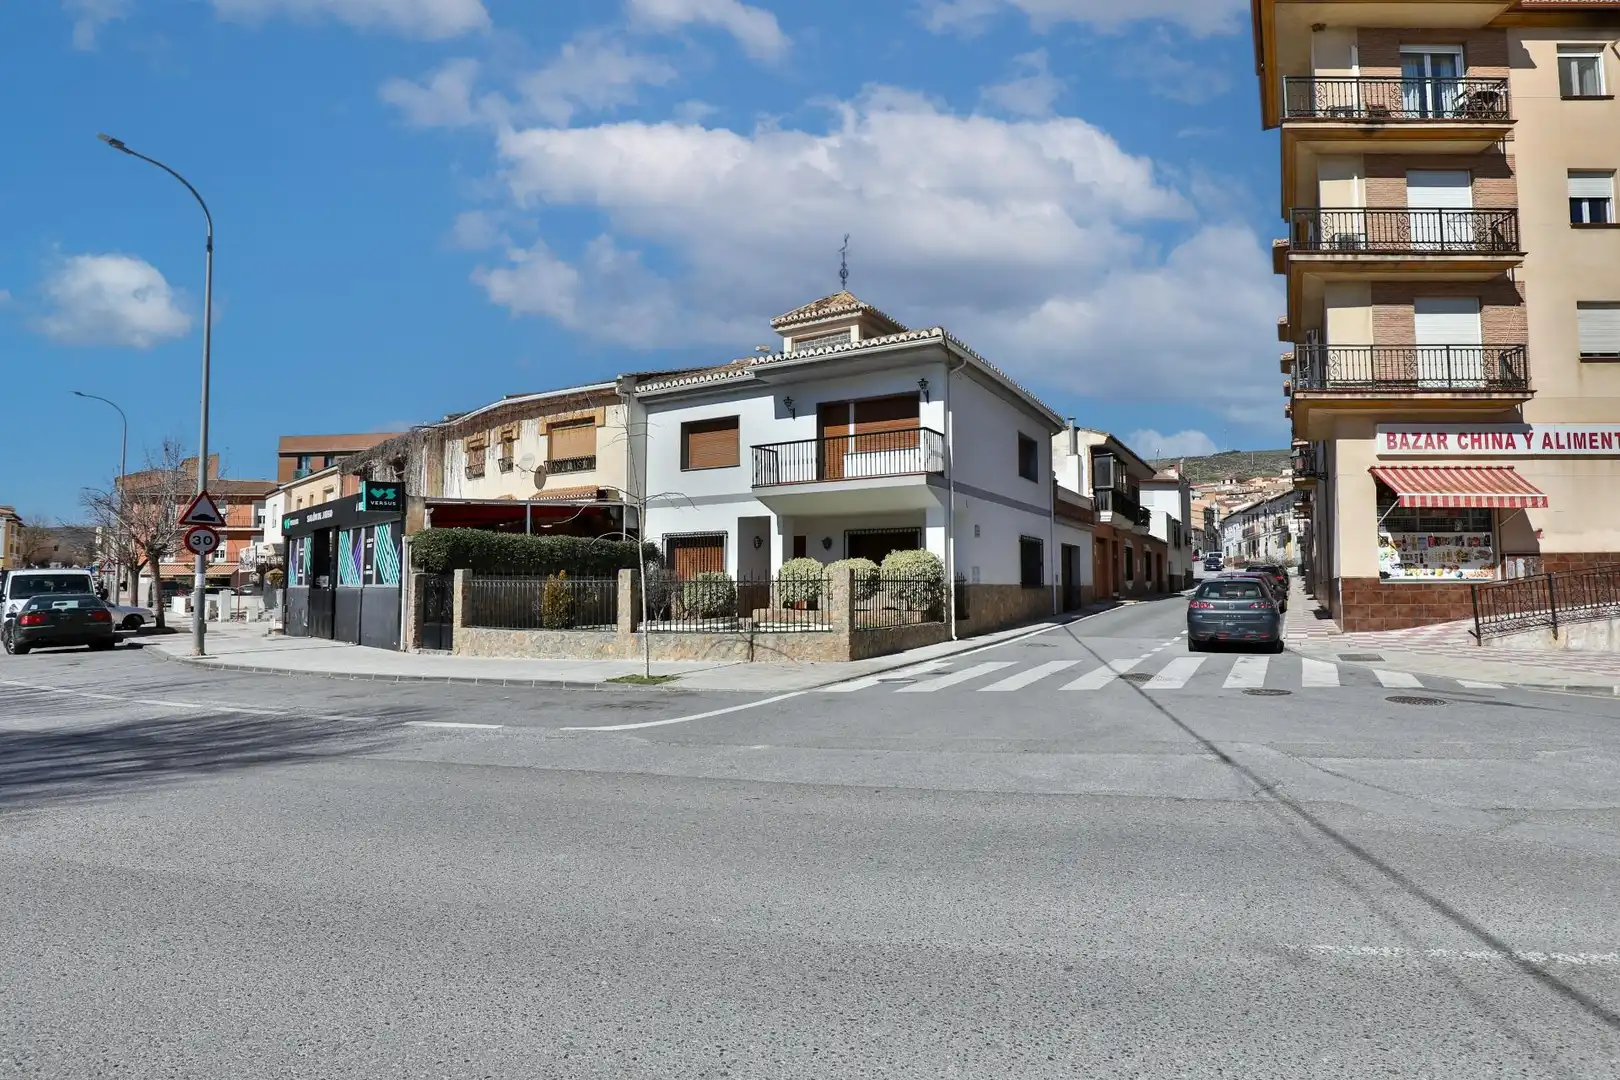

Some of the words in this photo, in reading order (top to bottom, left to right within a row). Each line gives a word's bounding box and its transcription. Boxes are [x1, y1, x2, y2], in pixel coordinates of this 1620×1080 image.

[1386, 432, 1449, 450] BAZAR
[1457, 432, 1517, 450] CHINA
[1522, 432, 1535, 450] Y
[192, 535, 213, 546] 30
